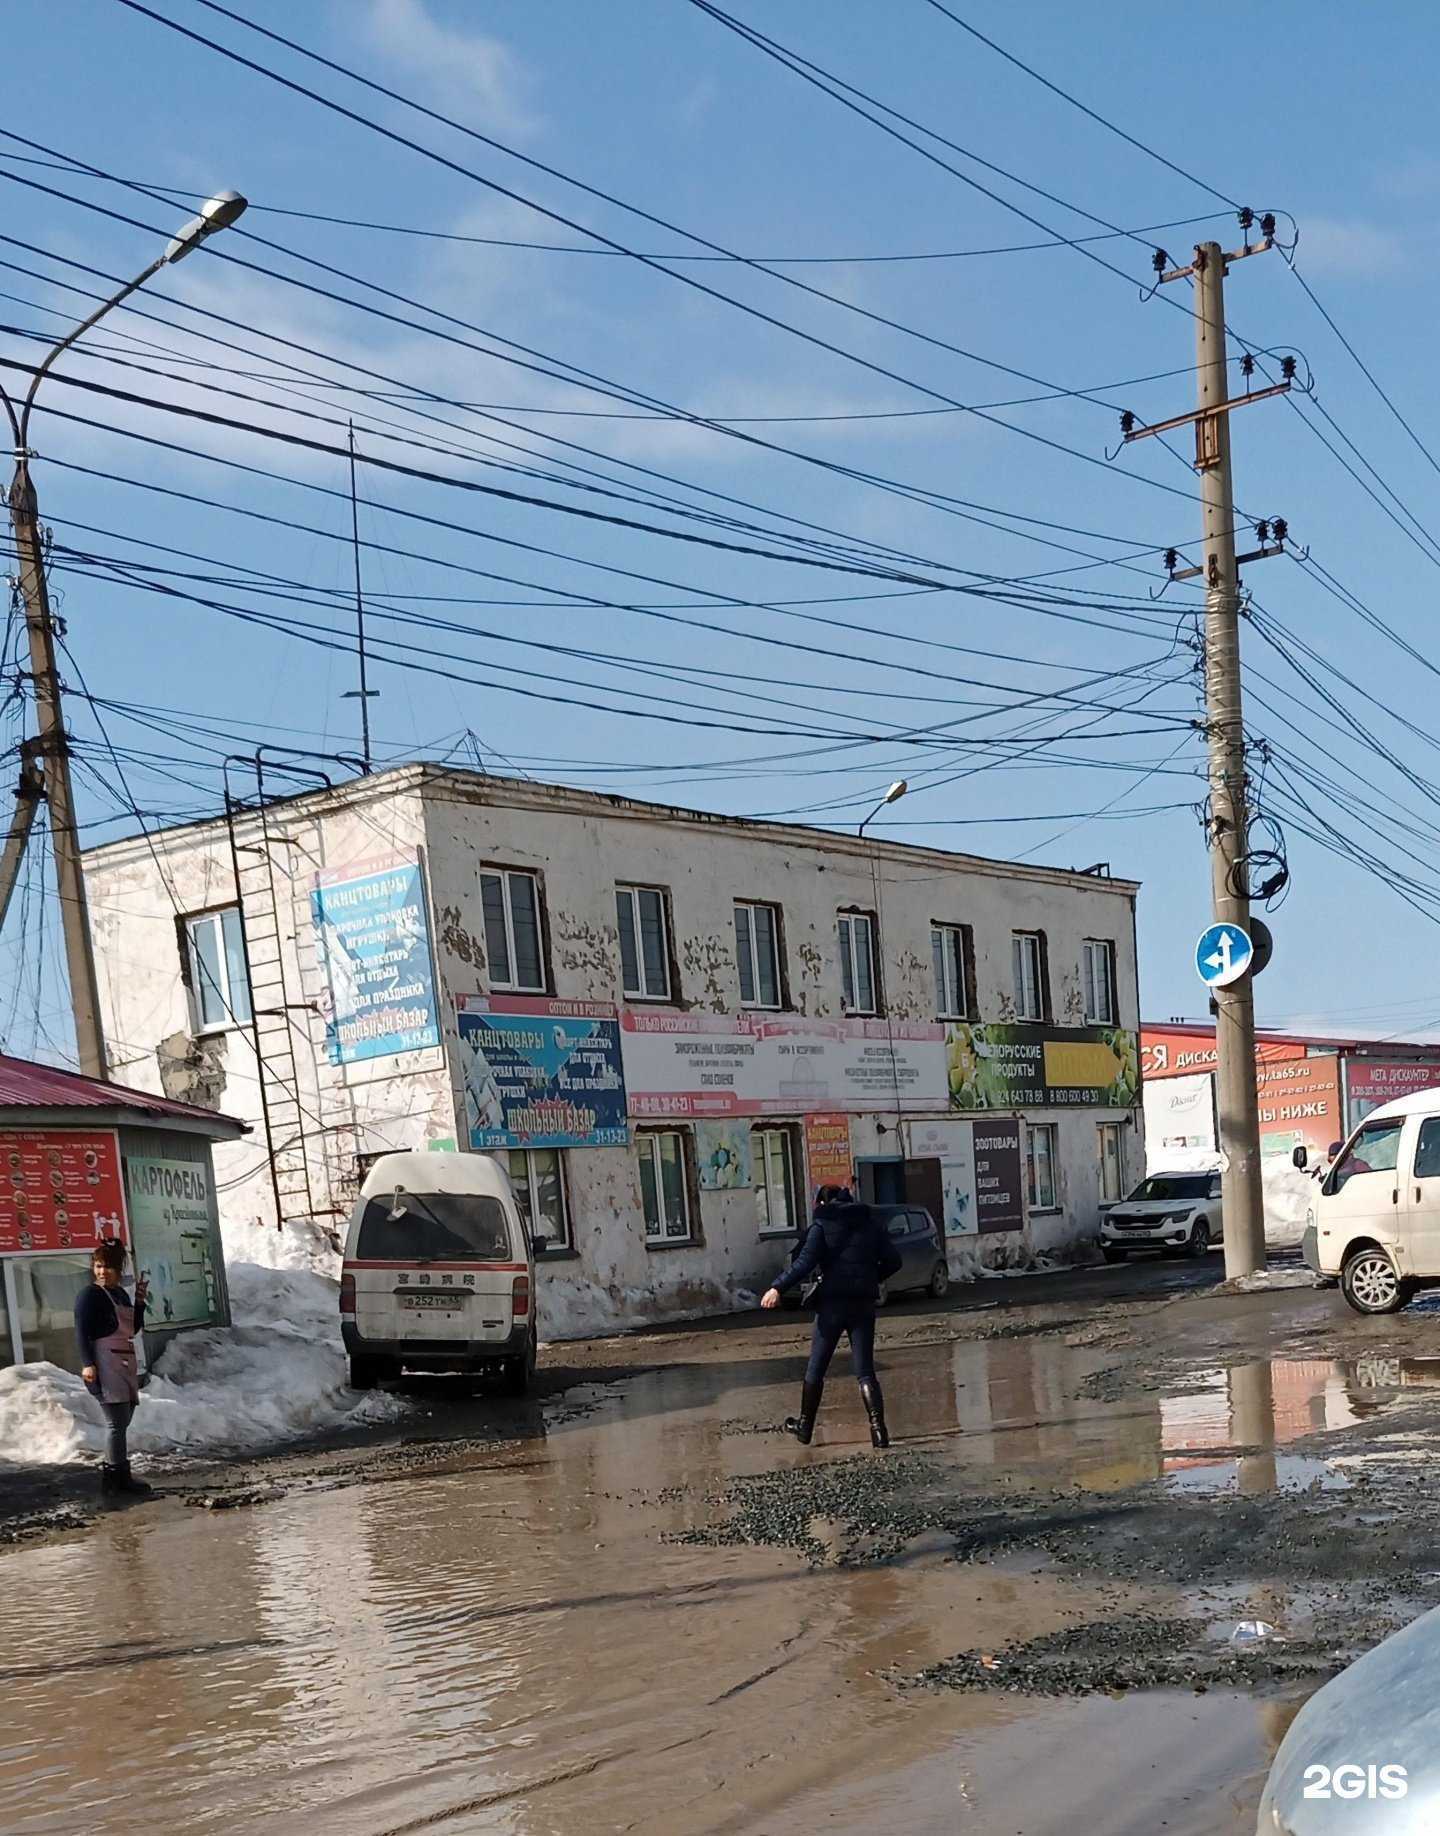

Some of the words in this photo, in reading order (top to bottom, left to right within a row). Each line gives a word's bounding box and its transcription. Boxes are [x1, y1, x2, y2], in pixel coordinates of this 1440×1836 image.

[325, 876, 408, 911] КАНЦТОВАРЫ
[373, 982, 425, 1003] ПРАЗДНИКА
[396, 1008, 429, 1030] БАЗАР
[468, 1028, 545, 1050] КАНЦТОВАРЫ
[992, 1063, 1035, 1078] ПРОДУКТЫ
[507, 1108, 564, 1133] ШКОЛЬНЫЙ
[567, 1109, 596, 1133] БАЗАР
[1280, 1101, 1328, 1120] НИЖЕ
[479, 1132, 484, 1146] 1
[975, 1136, 1018, 1151] ЗООТОВАРЫ
[130, 1164, 205, 1201] КАРТОФЕЛЬ
